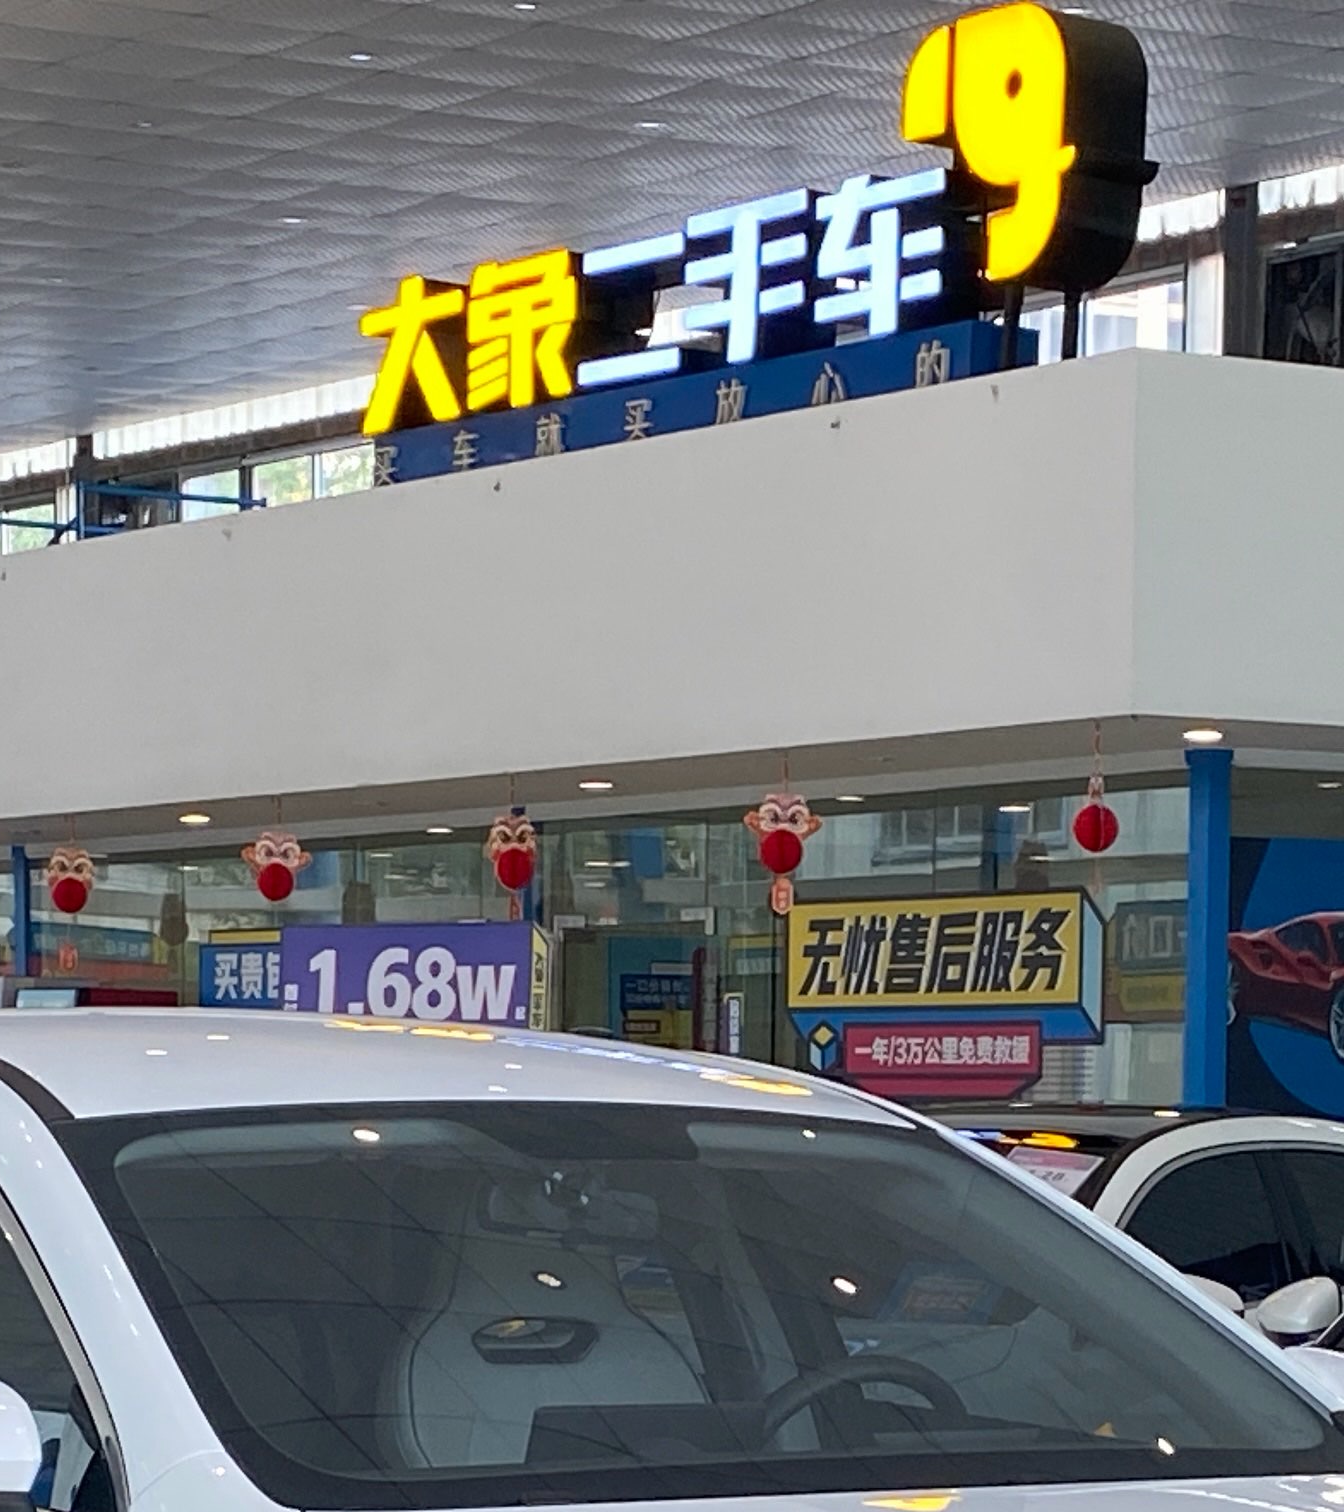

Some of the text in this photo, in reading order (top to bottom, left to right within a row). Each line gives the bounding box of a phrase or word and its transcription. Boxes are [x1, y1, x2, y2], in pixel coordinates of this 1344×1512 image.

[360, 167, 947, 436] 大象二手车
[799, 906, 1074, 997] 无忧售后服务
[855, 1035, 1030, 1068] 一年/3万公里免费救援
